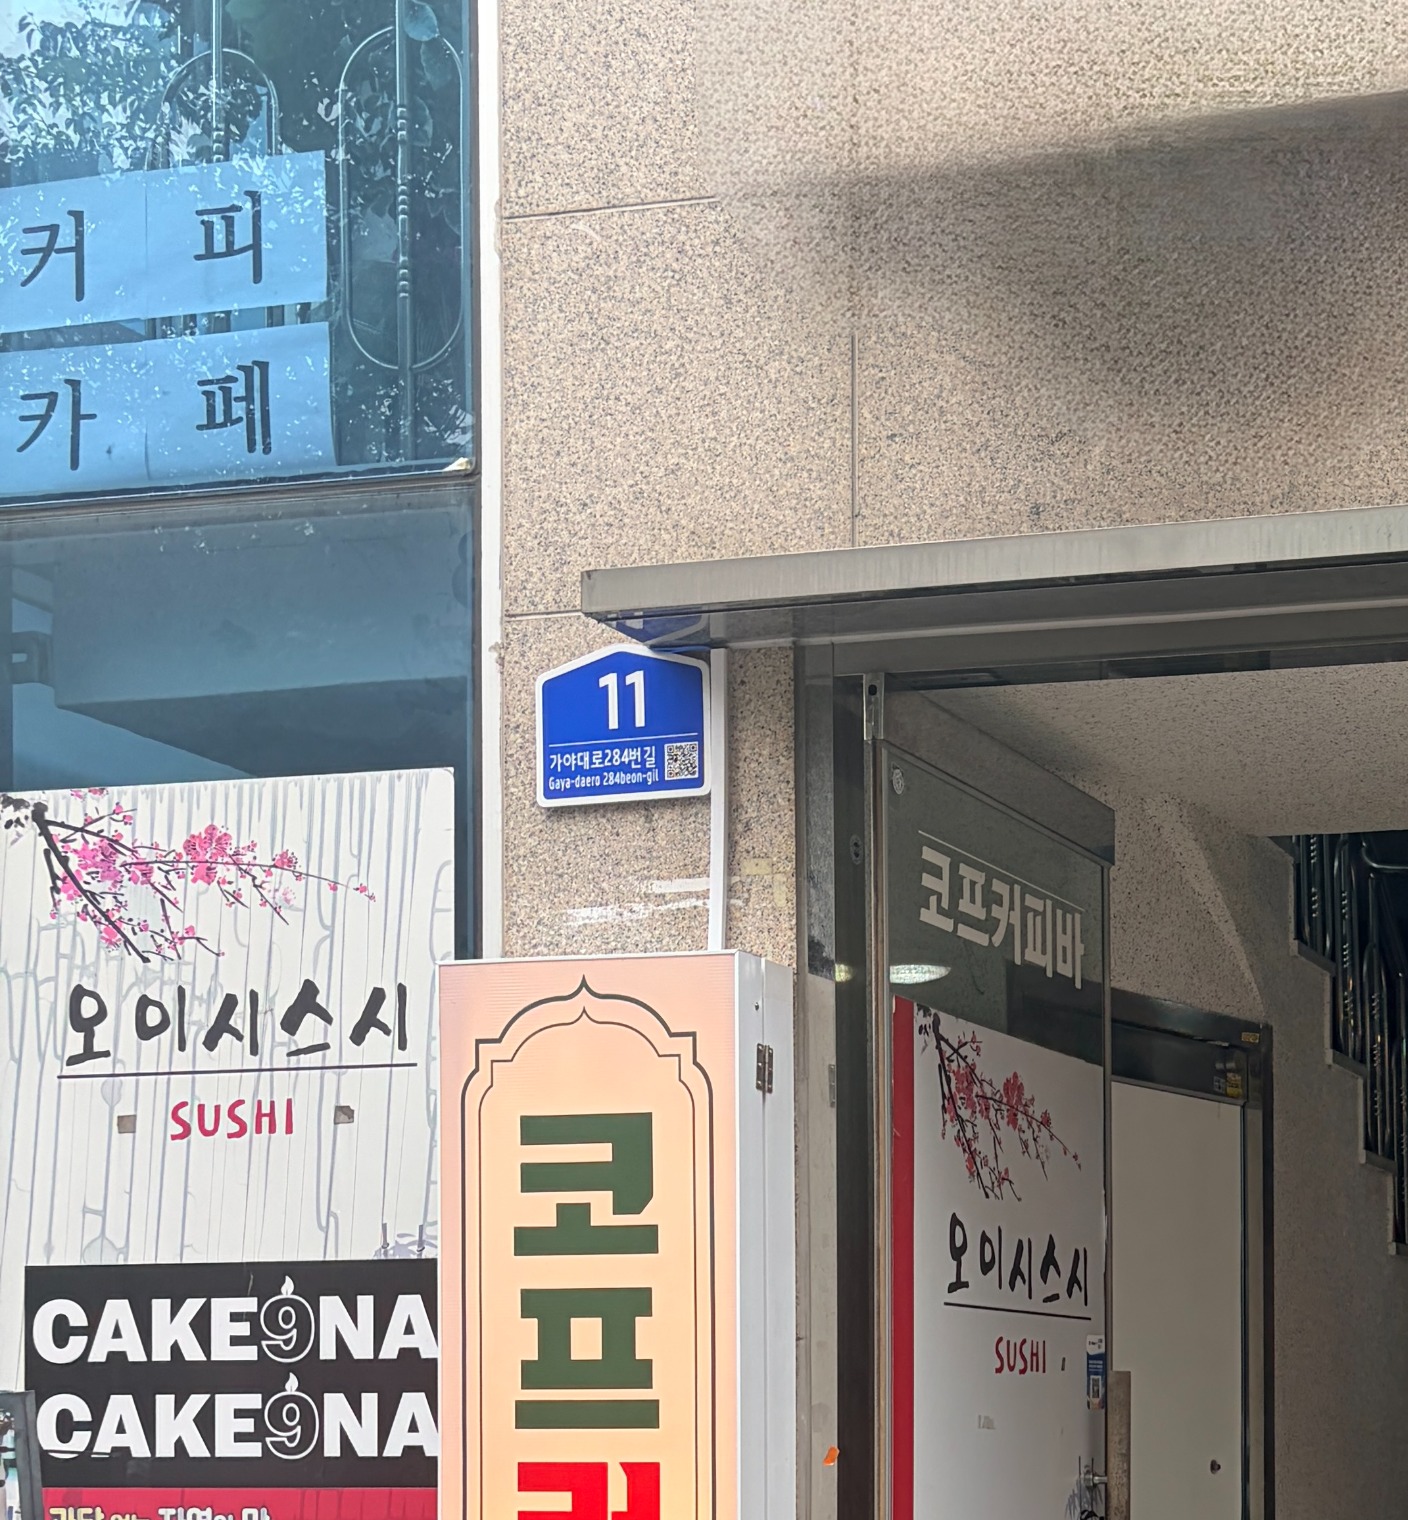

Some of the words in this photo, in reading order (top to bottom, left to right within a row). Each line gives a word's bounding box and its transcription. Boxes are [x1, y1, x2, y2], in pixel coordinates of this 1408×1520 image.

[20, 189, 263, 302] 커피
[16, 360, 272, 471] 카페
[598, 670, 646, 730] 11
[549, 745, 657, 773] 가야대로284번길
[549, 774, 601, 792] Gaya-daero
[603, 769, 659, 786] 284beon-gil
[919, 845, 1085, 990] 코프커피바
[66, 978, 408, 1067] 오이시스시
[171, 1097, 293, 1141] SUSHI
[947, 1211, 1089, 1307] 오이시스시
[994, 1336, 1047, 1376] SUSHI
